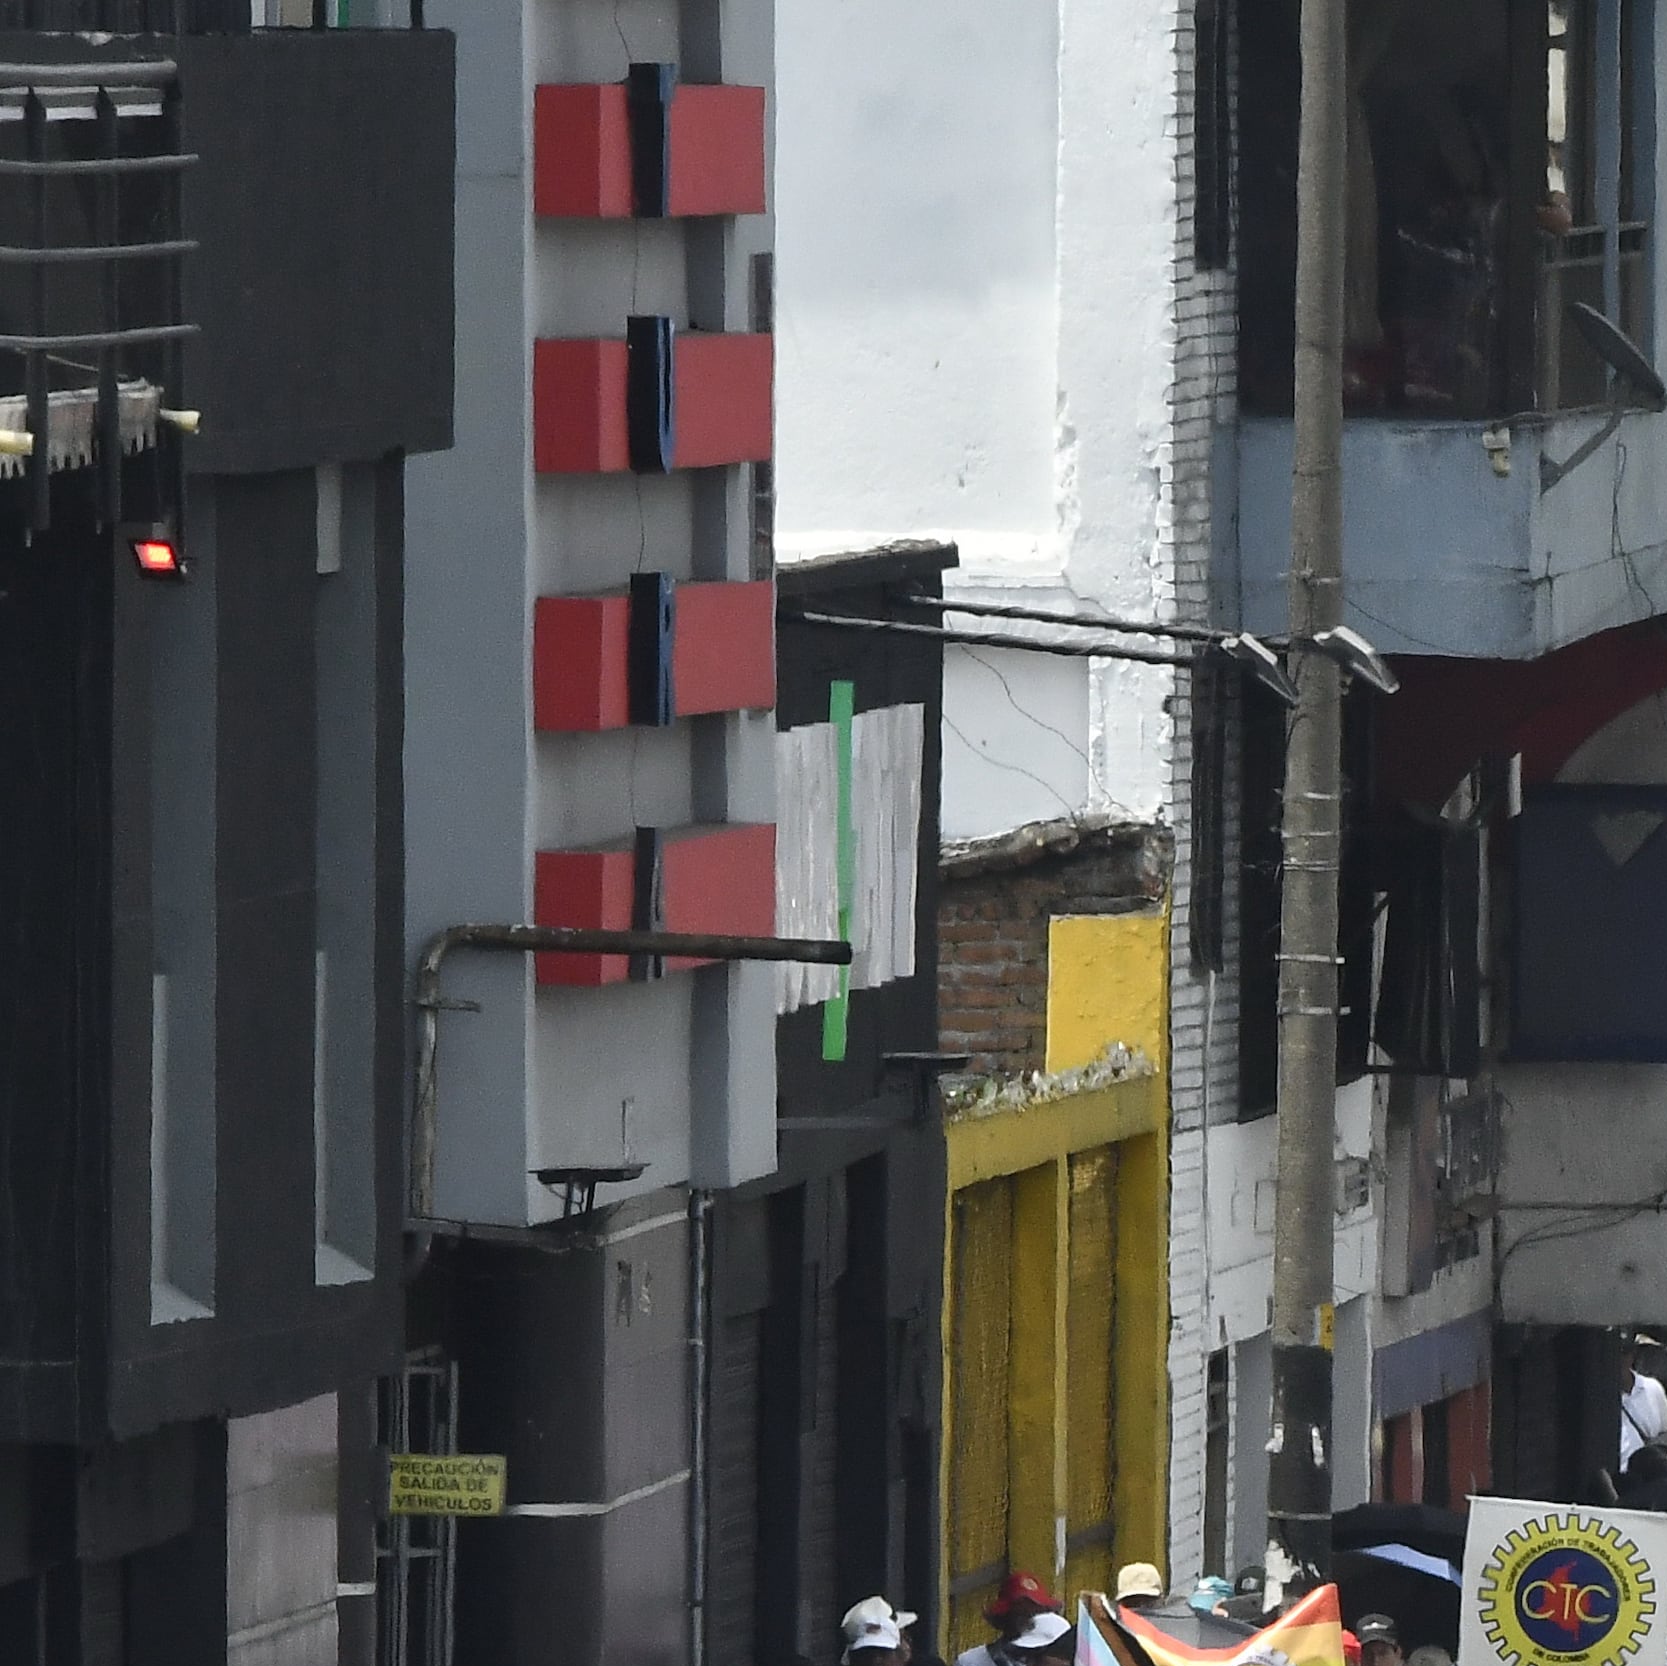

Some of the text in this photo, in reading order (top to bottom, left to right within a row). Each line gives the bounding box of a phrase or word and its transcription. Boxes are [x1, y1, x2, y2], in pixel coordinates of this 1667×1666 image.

[399, 1476, 489, 1493] SALIDA DE
[394, 1494, 493, 1511] VEHICULOS
[1522, 1579, 1612, 1624] CTC
